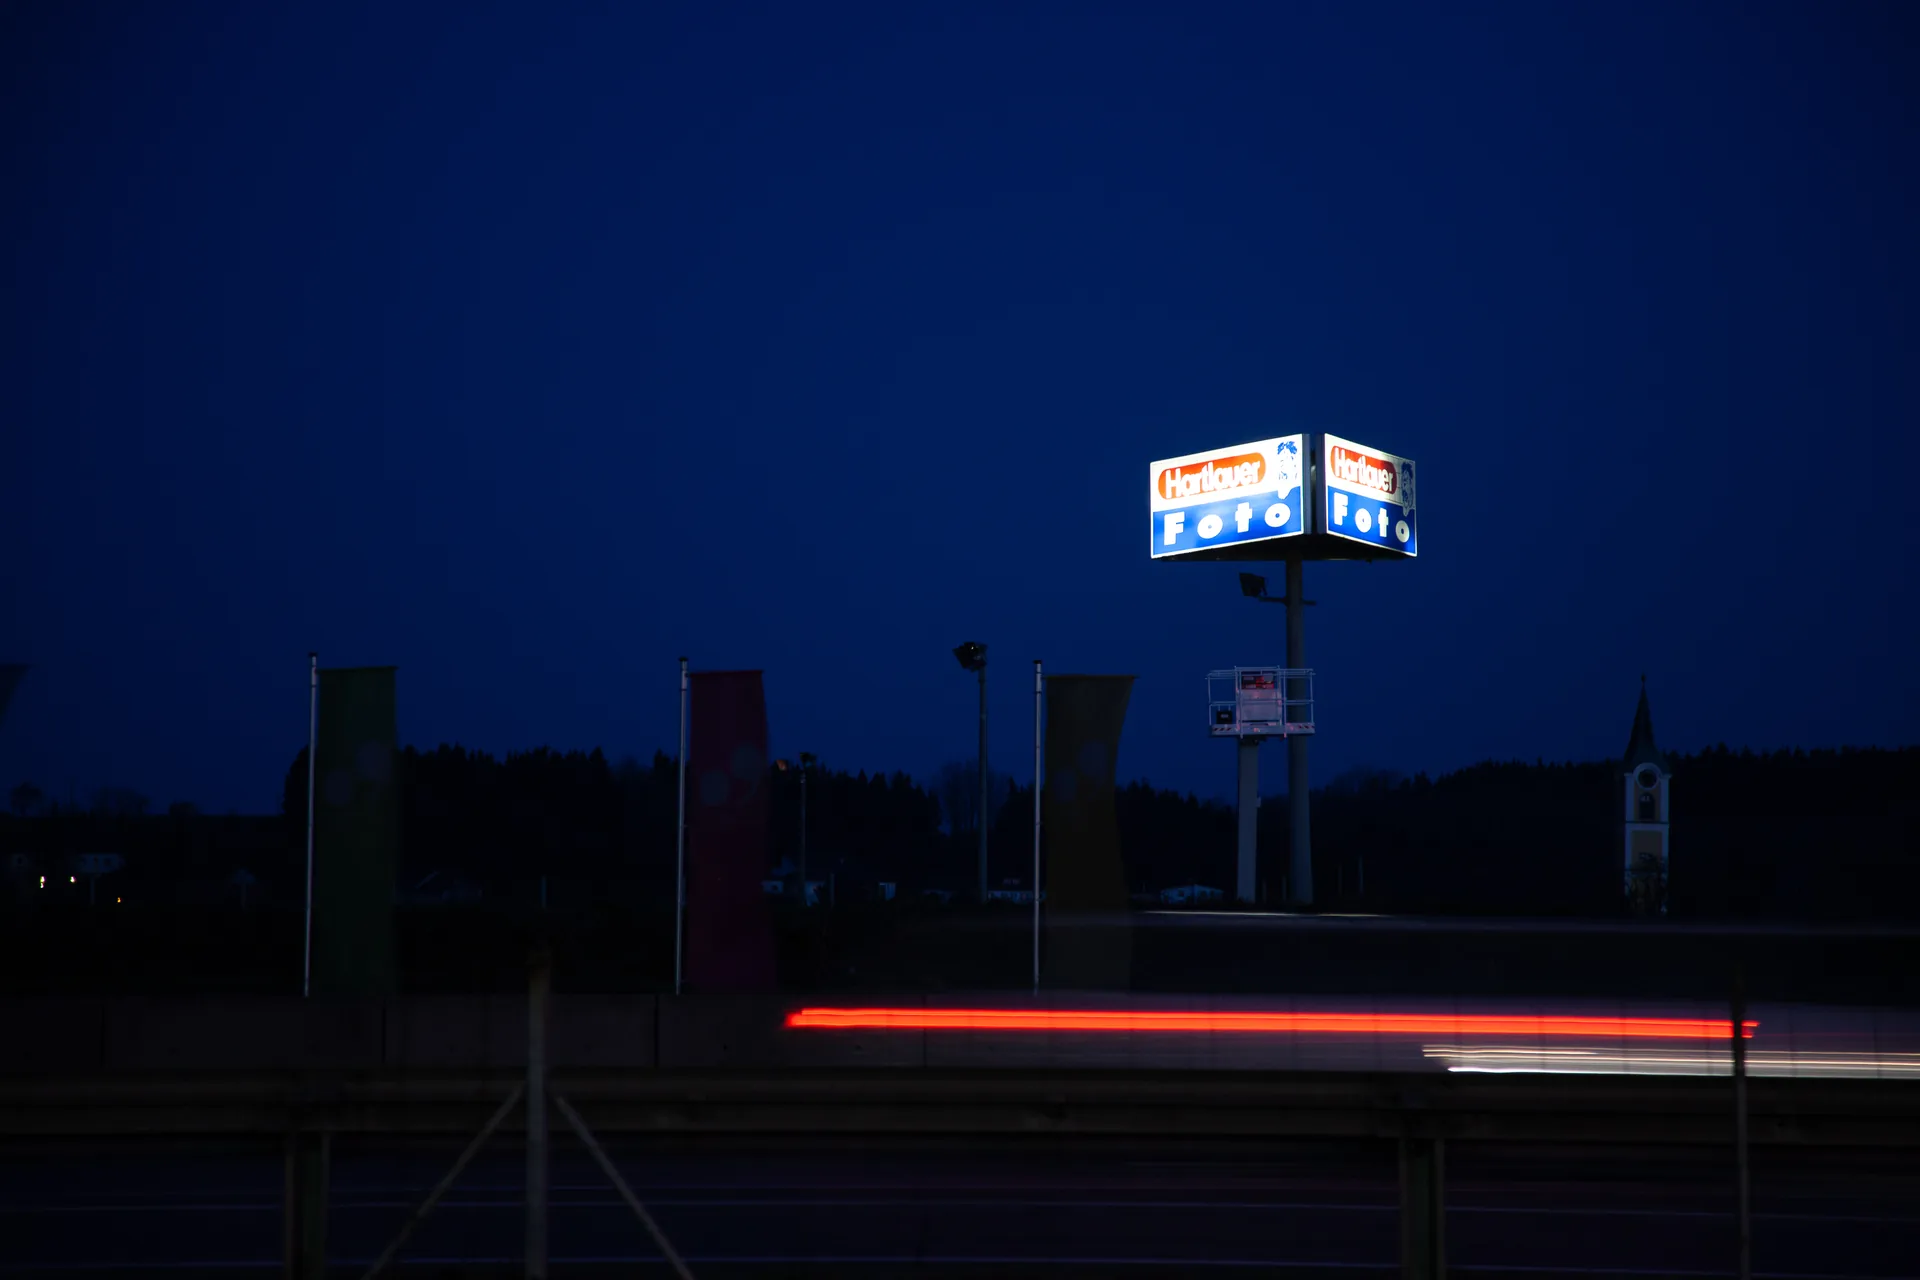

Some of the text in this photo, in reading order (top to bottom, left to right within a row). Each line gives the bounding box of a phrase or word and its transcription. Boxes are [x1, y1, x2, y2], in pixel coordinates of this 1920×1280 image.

[1165, 459, 1261, 499] Hartlauer
[1334, 447, 1394, 492] Hartlauer
[1163, 501, 1291, 545] Foto
[1333, 492, 1410, 543] Foto
